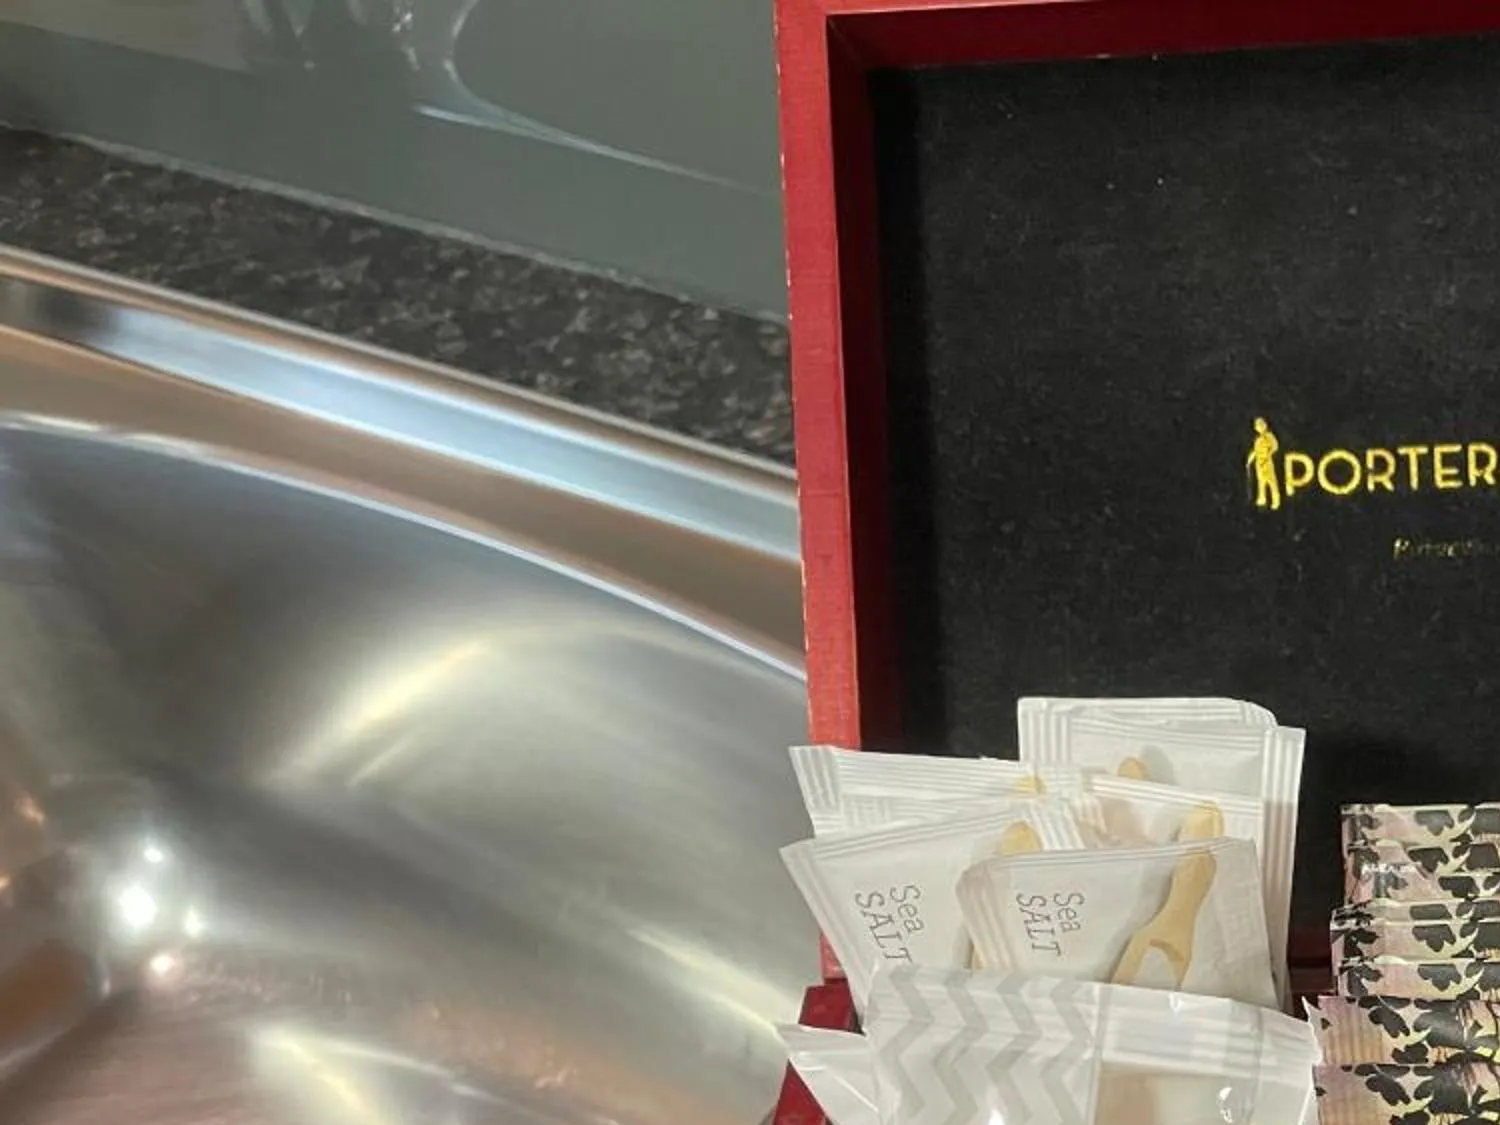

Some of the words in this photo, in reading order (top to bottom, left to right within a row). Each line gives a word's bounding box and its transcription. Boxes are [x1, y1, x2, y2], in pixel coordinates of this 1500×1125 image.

[854, 890, 913, 963] SALT
[889, 884, 925, 935] Sea
[1015, 892, 1061, 957] SALT
[1053, 891, 1086, 934] Sea
